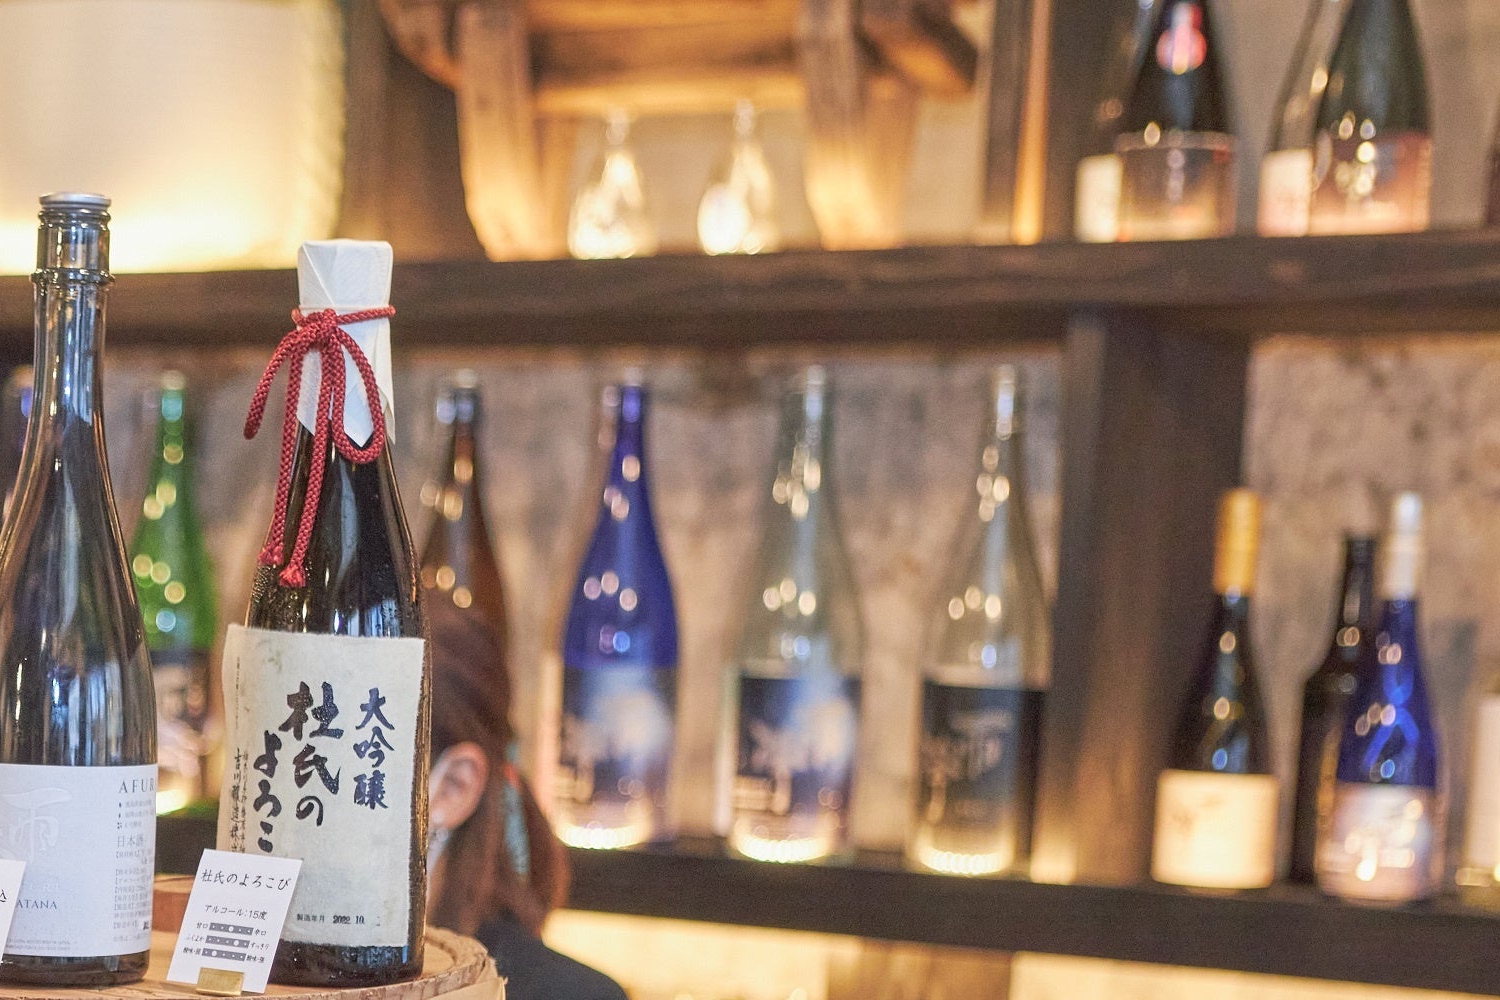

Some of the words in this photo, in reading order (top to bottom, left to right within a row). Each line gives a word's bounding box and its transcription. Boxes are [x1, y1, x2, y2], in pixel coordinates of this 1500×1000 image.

[279, 681, 344, 827] 杜氏の
[353, 687, 395, 810] 大吟醸
[118, 778, 155, 794] AFUR
[253, 730, 283, 852] よろこ
[16, 899, 58, 910] ATANA
[201, 869, 291, 891] 杜氏のよろこび
